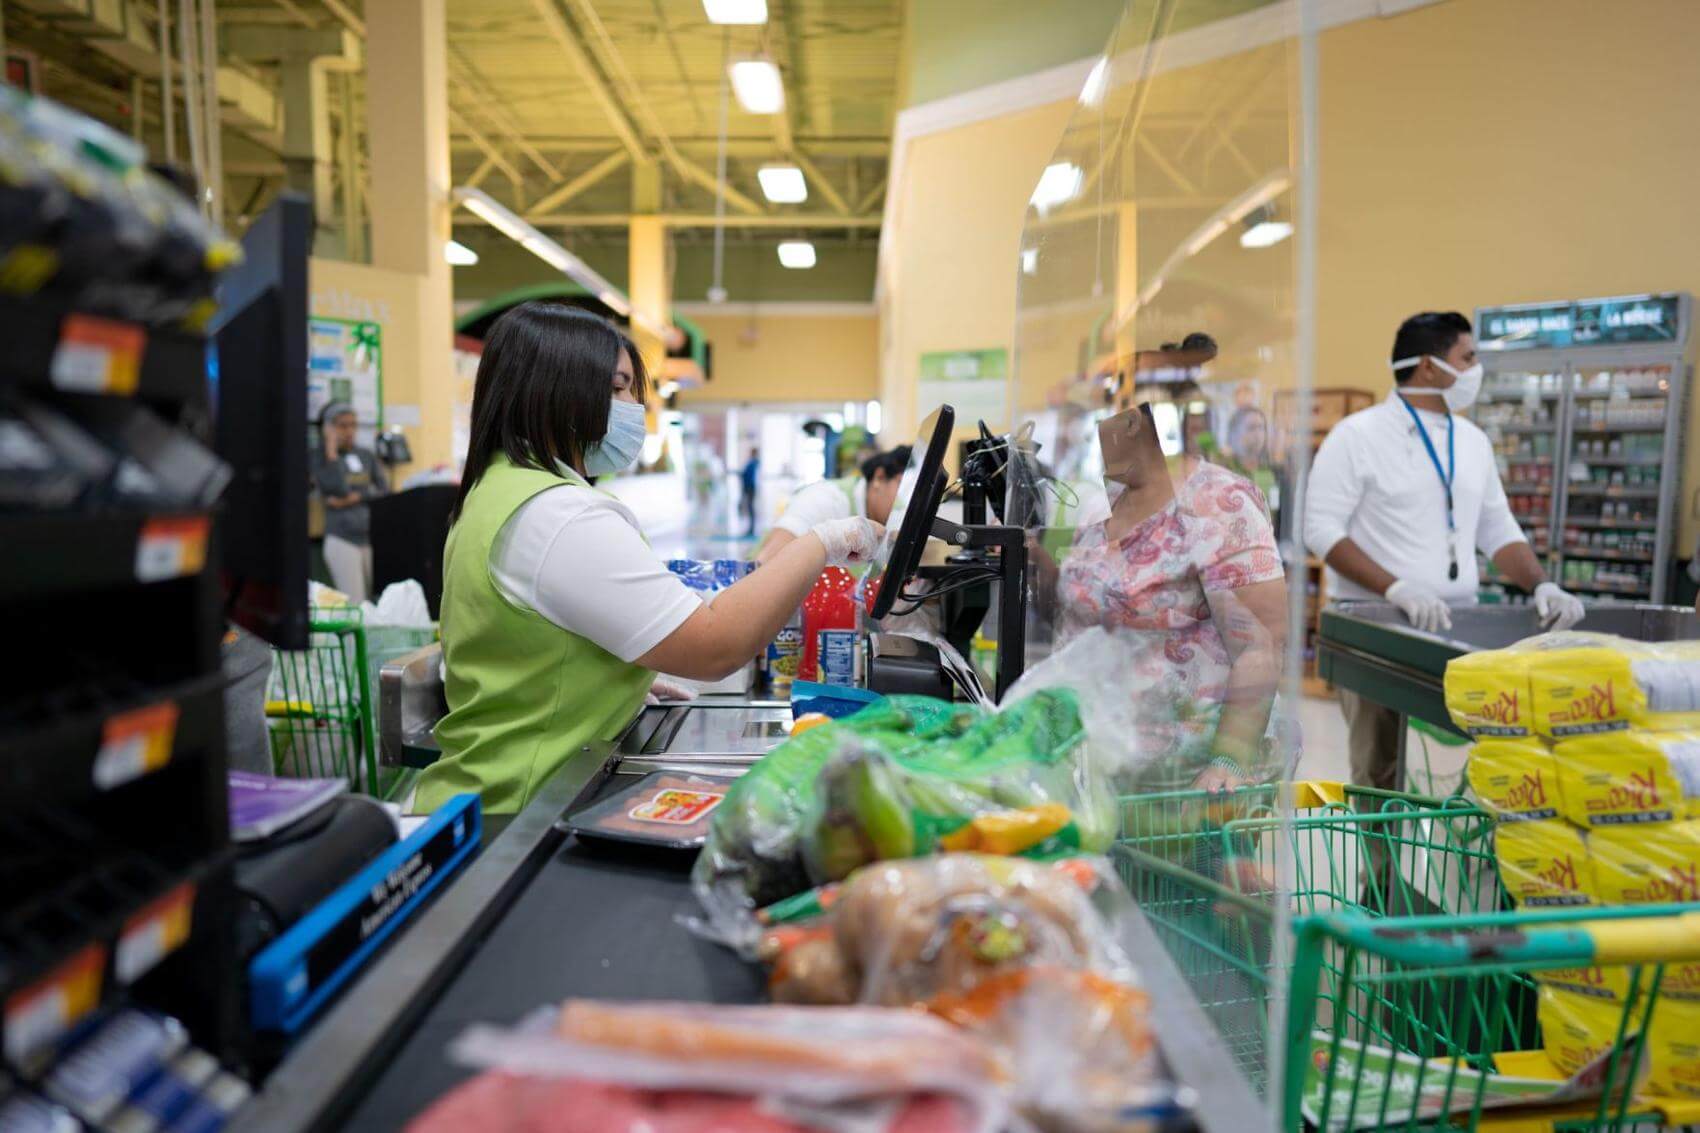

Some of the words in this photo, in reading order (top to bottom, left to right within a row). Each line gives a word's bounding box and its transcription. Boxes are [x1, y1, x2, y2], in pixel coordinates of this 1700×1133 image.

[1481, 688, 1519, 724] Rico
[1569, 678, 1618, 721] Rico
[1507, 768, 1547, 808] Rico
